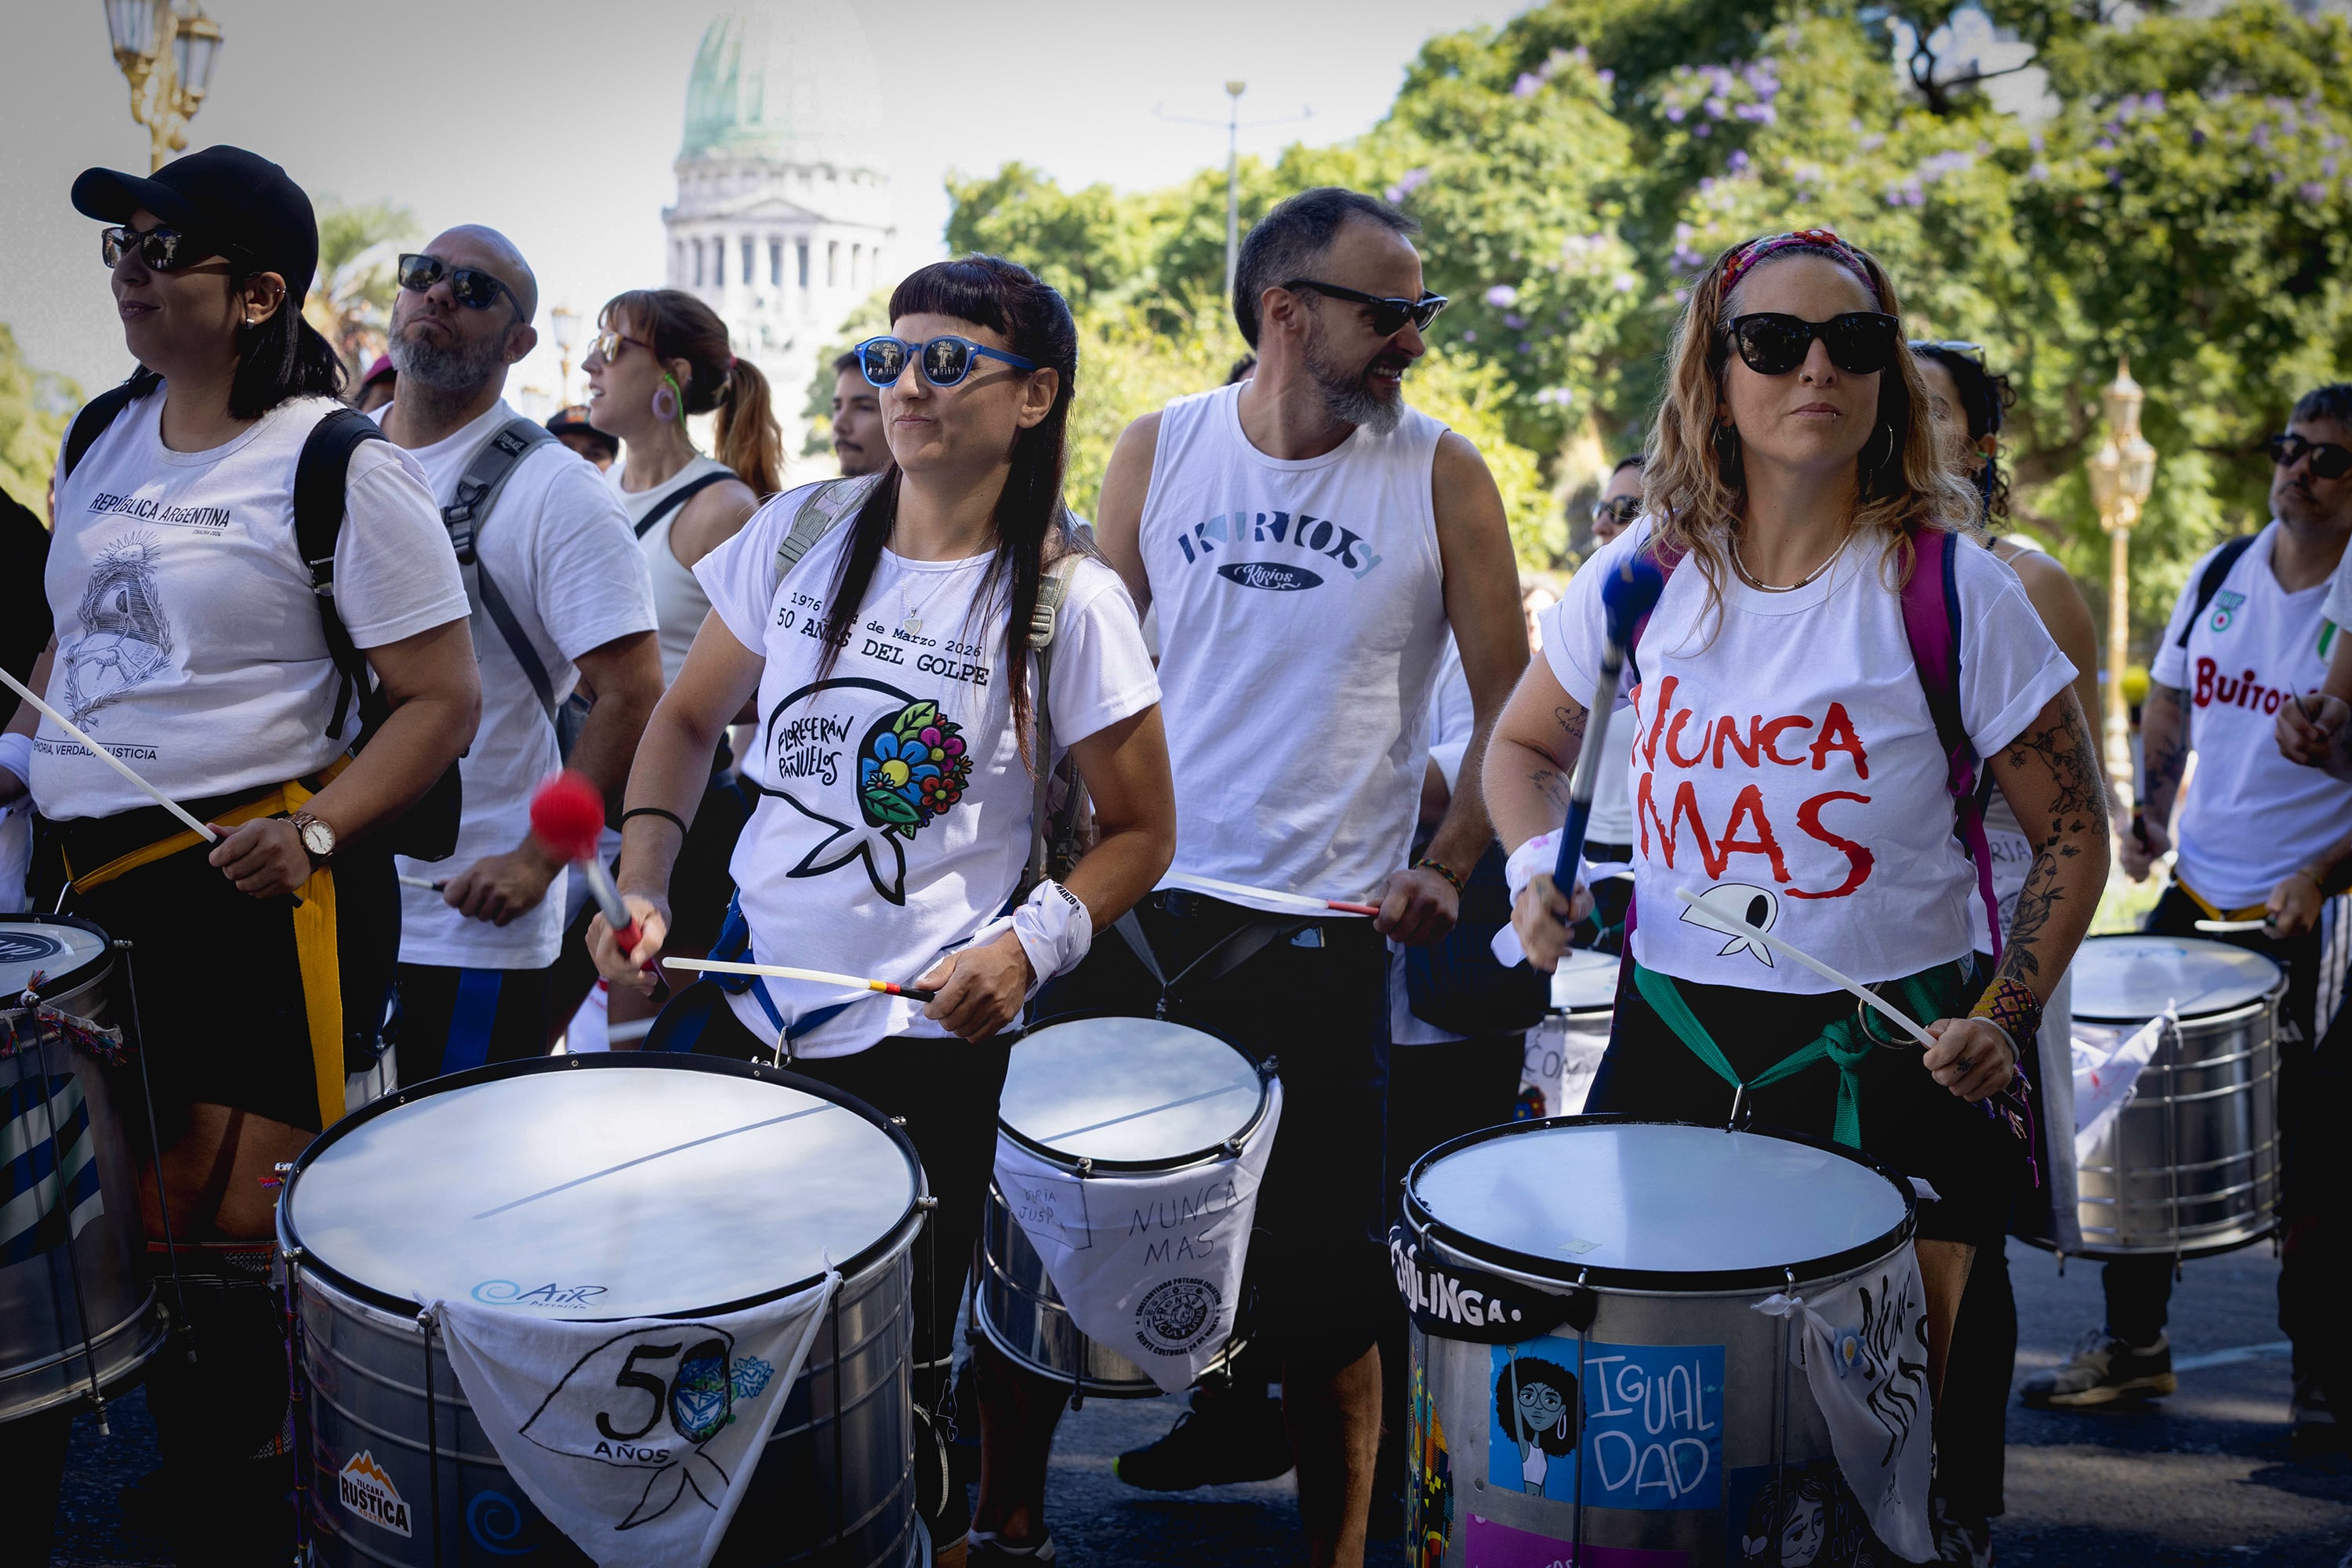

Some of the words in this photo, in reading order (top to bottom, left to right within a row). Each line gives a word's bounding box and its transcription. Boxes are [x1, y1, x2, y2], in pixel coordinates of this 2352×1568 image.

[89, 492, 159, 520] REPÚBLICA
[158, 506, 230, 528] ARGENTINA
[1178, 511, 1383, 580] KIRIOS
[1236, 564, 1301, 589] Kirios
[777, 607, 795, 629] 50
[862, 639, 905, 666] DEL
[917, 654, 989, 687] GOLPE
[790, 592, 822, 612] 1976
[866, 620, 885, 634] de
[892, 628, 937, 648] Marzo
[945, 640, 983, 657] 2026
[779, 714, 854, 755] FLORECERÁN
[1631, 676, 1869, 780] NUNCA
[779, 746, 842, 786] PAÑUELOS
[1638, 772, 1875, 898] MAS
[1054, 885, 1077, 905] MARZO
[1129, 1179, 1245, 1236] NUNCA
[1144, 1229, 1214, 1266] MAS
[1153, 1346, 1188, 1356] CULTURAL
[1189, 1341, 1197, 1352] 24
[596, 1338, 731, 1445] 50
[1584, 1355, 1715, 1435] IGUAL
[594, 1442, 671, 1464] AÑOS
[1594, 1430, 1710, 1500] DAD
[341, 1475, 409, 1533] RUSTICA
[356, 1479, 385, 1497] TILCARA
[358, 1508, 387, 1526] HOSTEL
